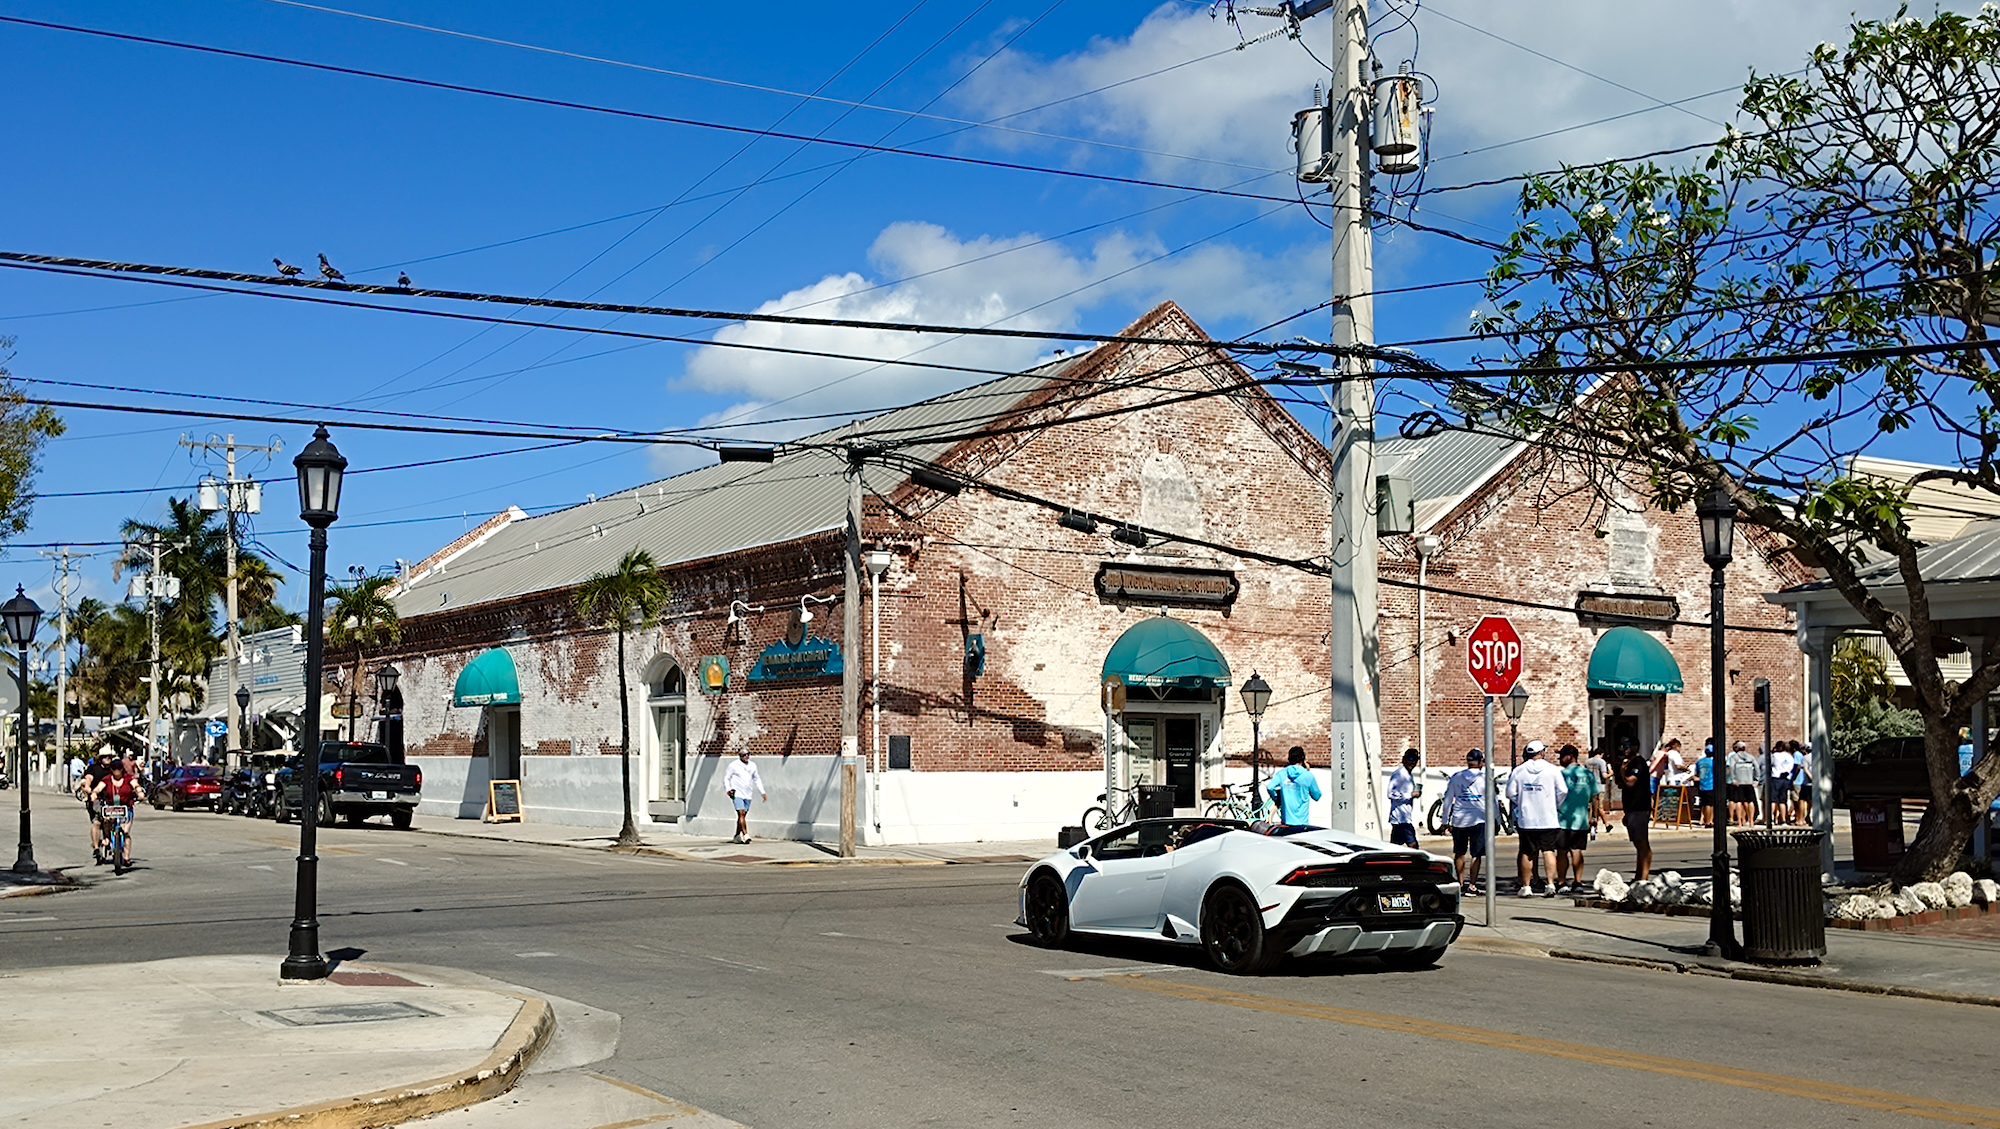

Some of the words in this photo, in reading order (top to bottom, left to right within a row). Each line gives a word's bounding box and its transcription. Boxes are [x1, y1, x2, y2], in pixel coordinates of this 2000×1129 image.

[1471, 640, 1519, 671] STOP
[1627, 682, 1649, 690] Social
[1650, 683, 1665, 692] Club
[1338, 801, 1348, 810] ST
[1365, 822, 1375, 831] ST
